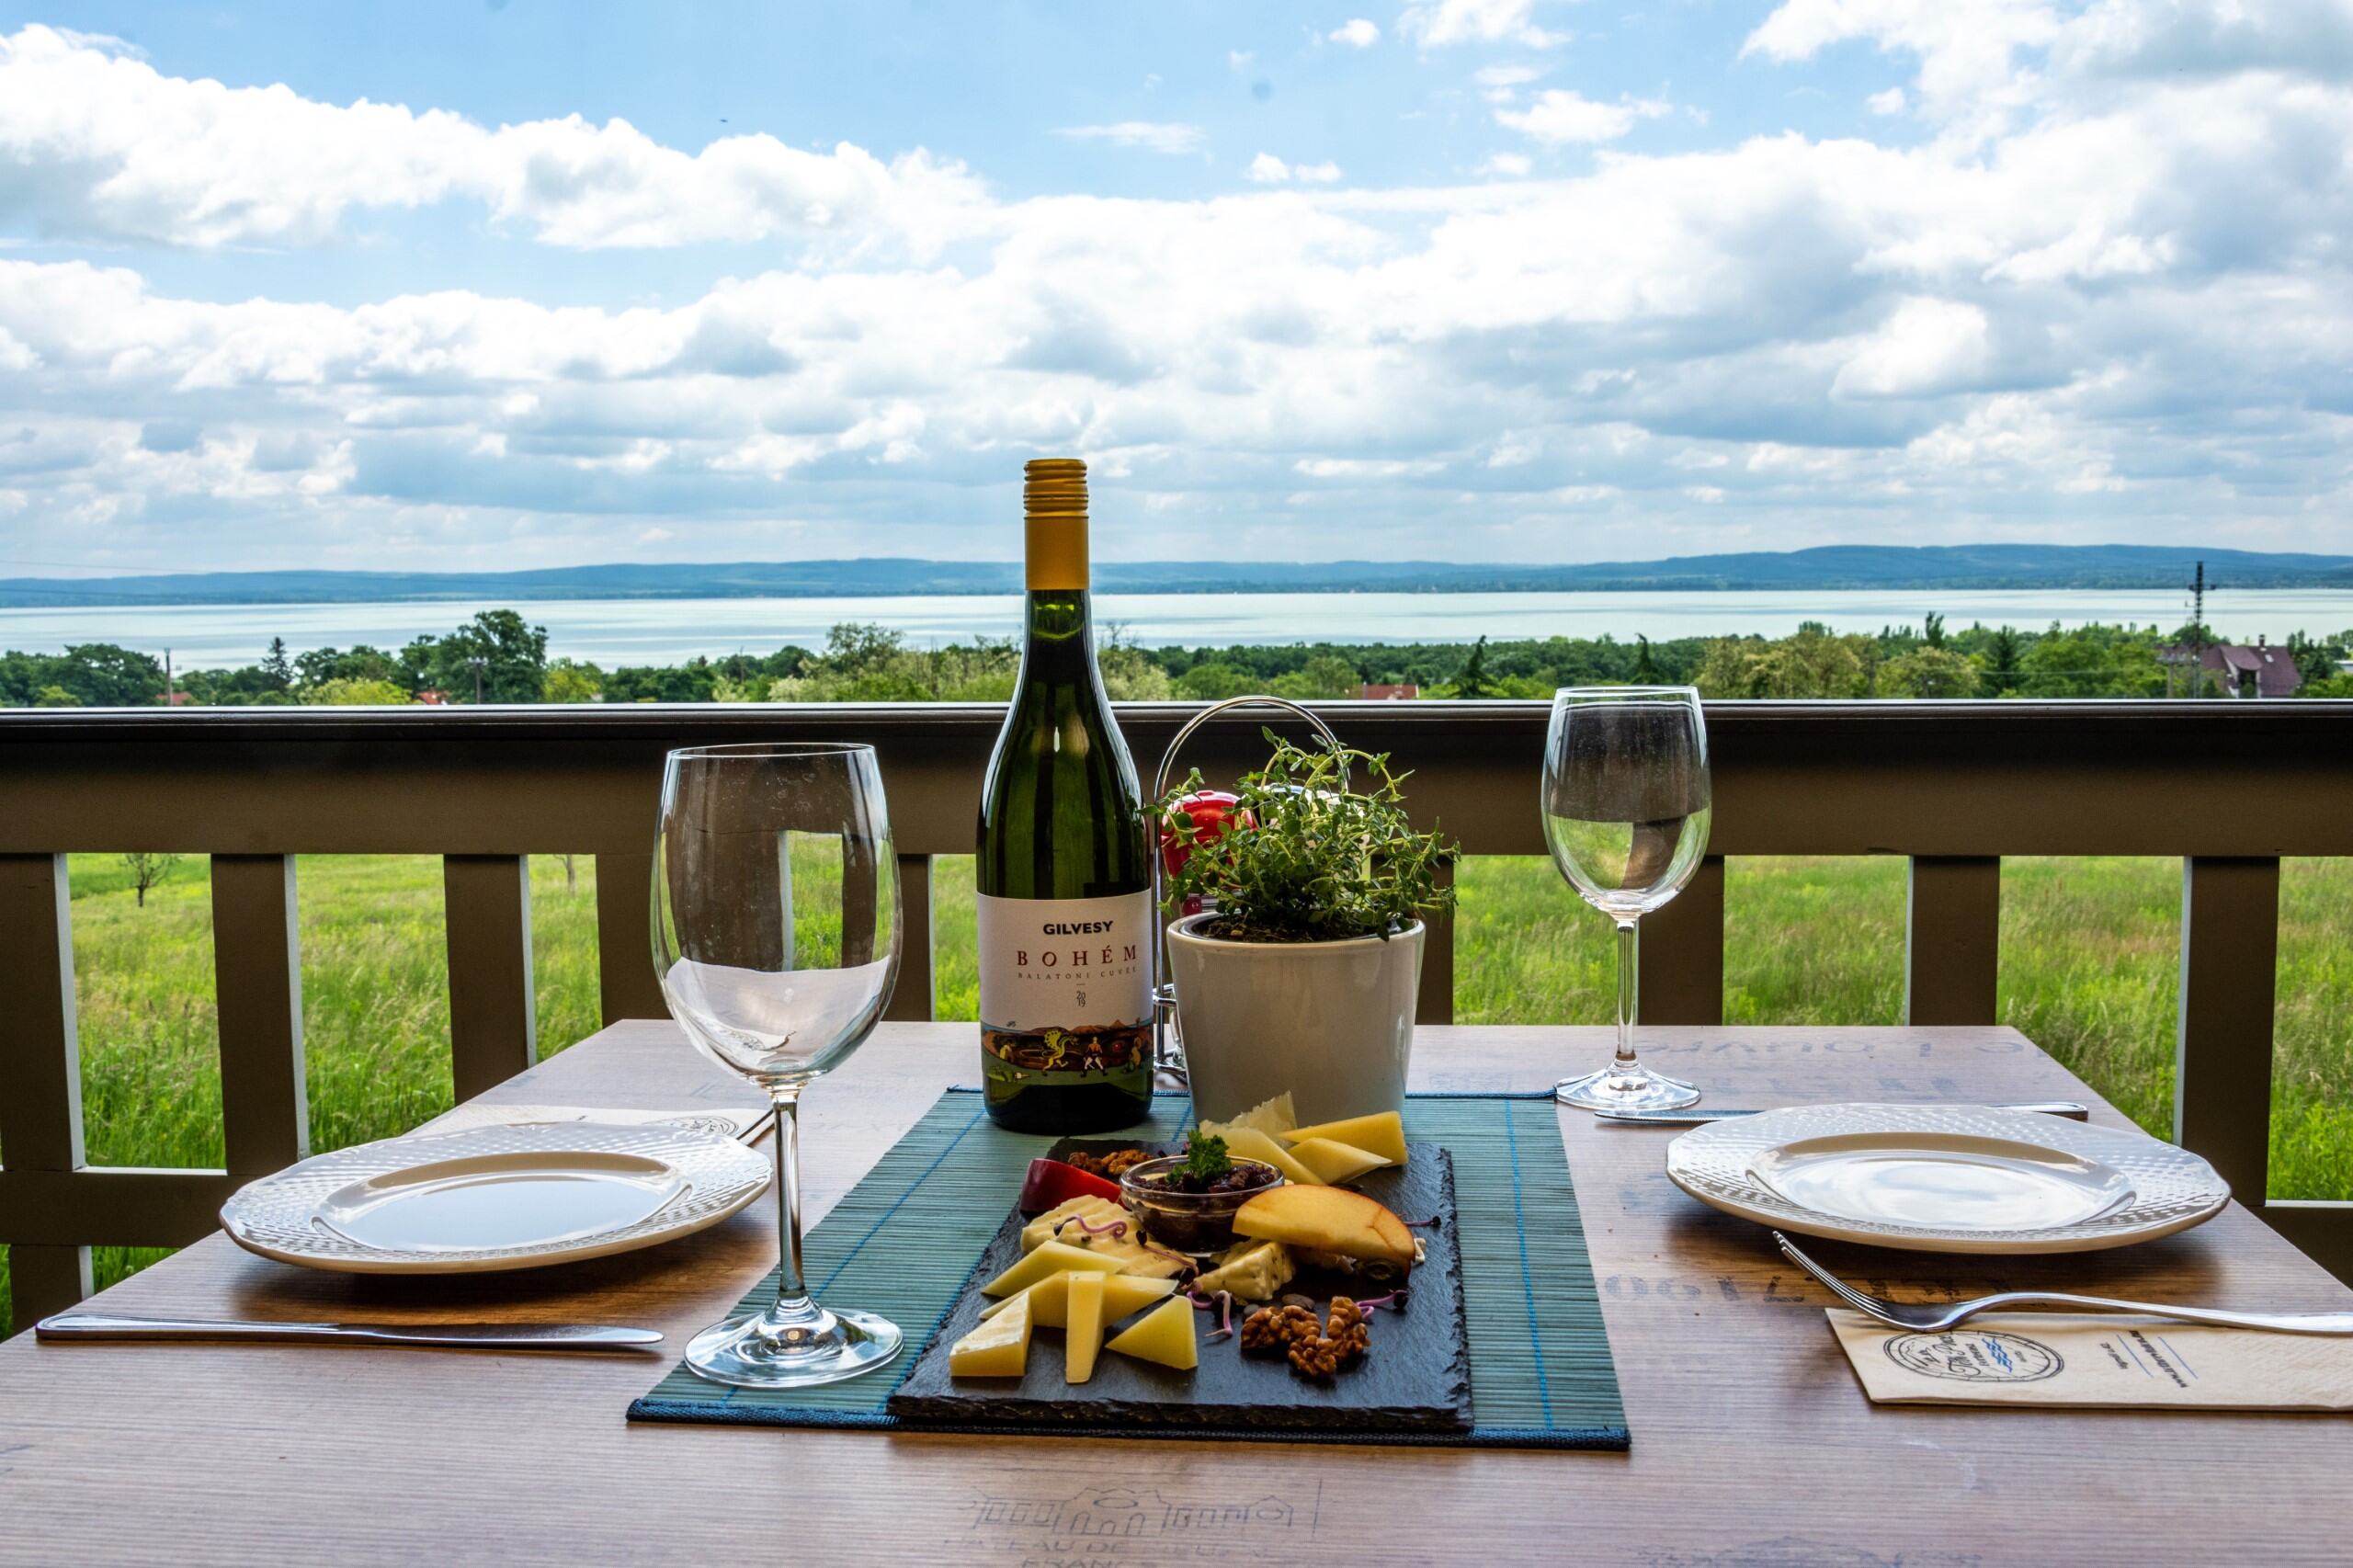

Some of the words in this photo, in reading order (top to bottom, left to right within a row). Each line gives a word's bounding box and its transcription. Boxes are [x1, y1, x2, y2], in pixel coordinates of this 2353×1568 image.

[1043, 920, 1114, 936] GILVESY
[1017, 944, 1137, 967] BOHÉM
[1017, 971, 1090, 980] BALATONI
[1100, 965, 1137, 977] CUVÉE
